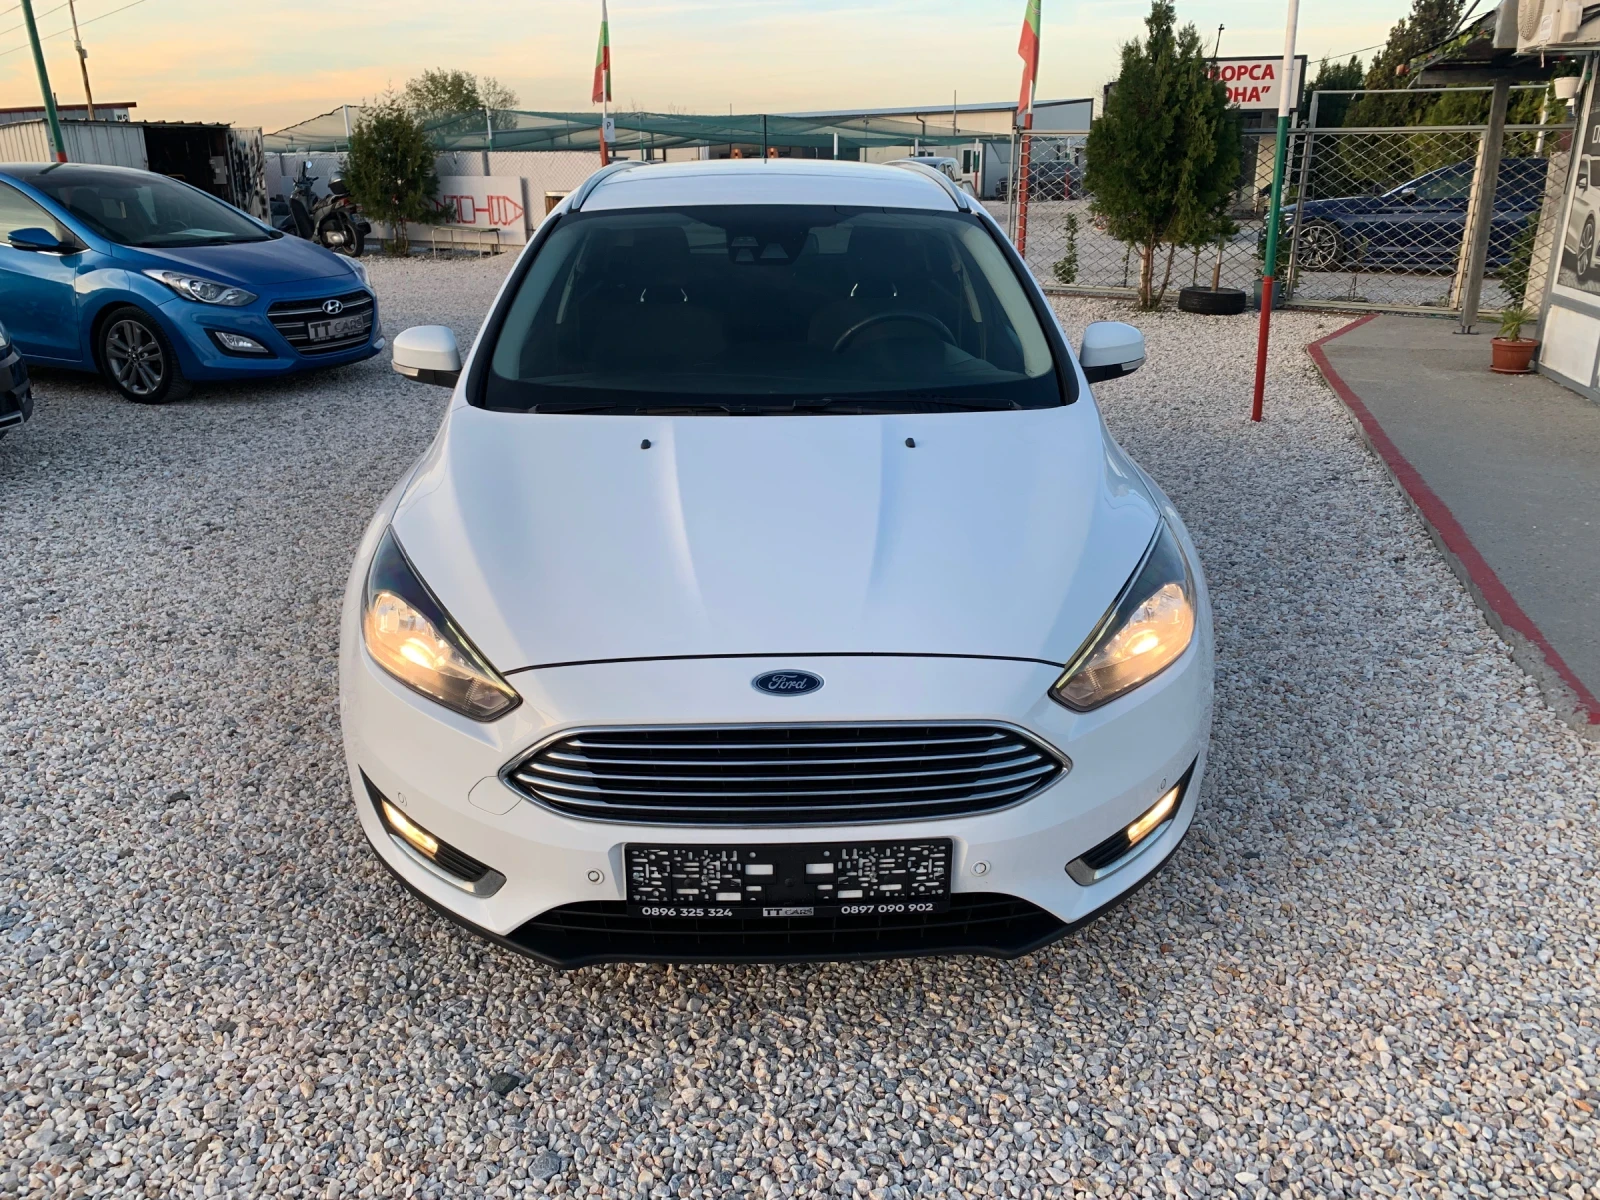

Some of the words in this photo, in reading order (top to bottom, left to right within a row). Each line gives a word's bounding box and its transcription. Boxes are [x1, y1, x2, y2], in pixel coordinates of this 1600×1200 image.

[310, 321, 331, 338] TT
[334, 317, 363, 333] CARS
[768, 674, 808, 690] Ford
[641, 906, 677, 916] 0896
[679, 907, 705, 917] 325
[707, 908, 733, 917] 324
[764, 908, 783, 916] TT
[840, 905, 875, 914] 0897
[877, 904, 905, 913] 090
[908, 903, 934, 912] 902
